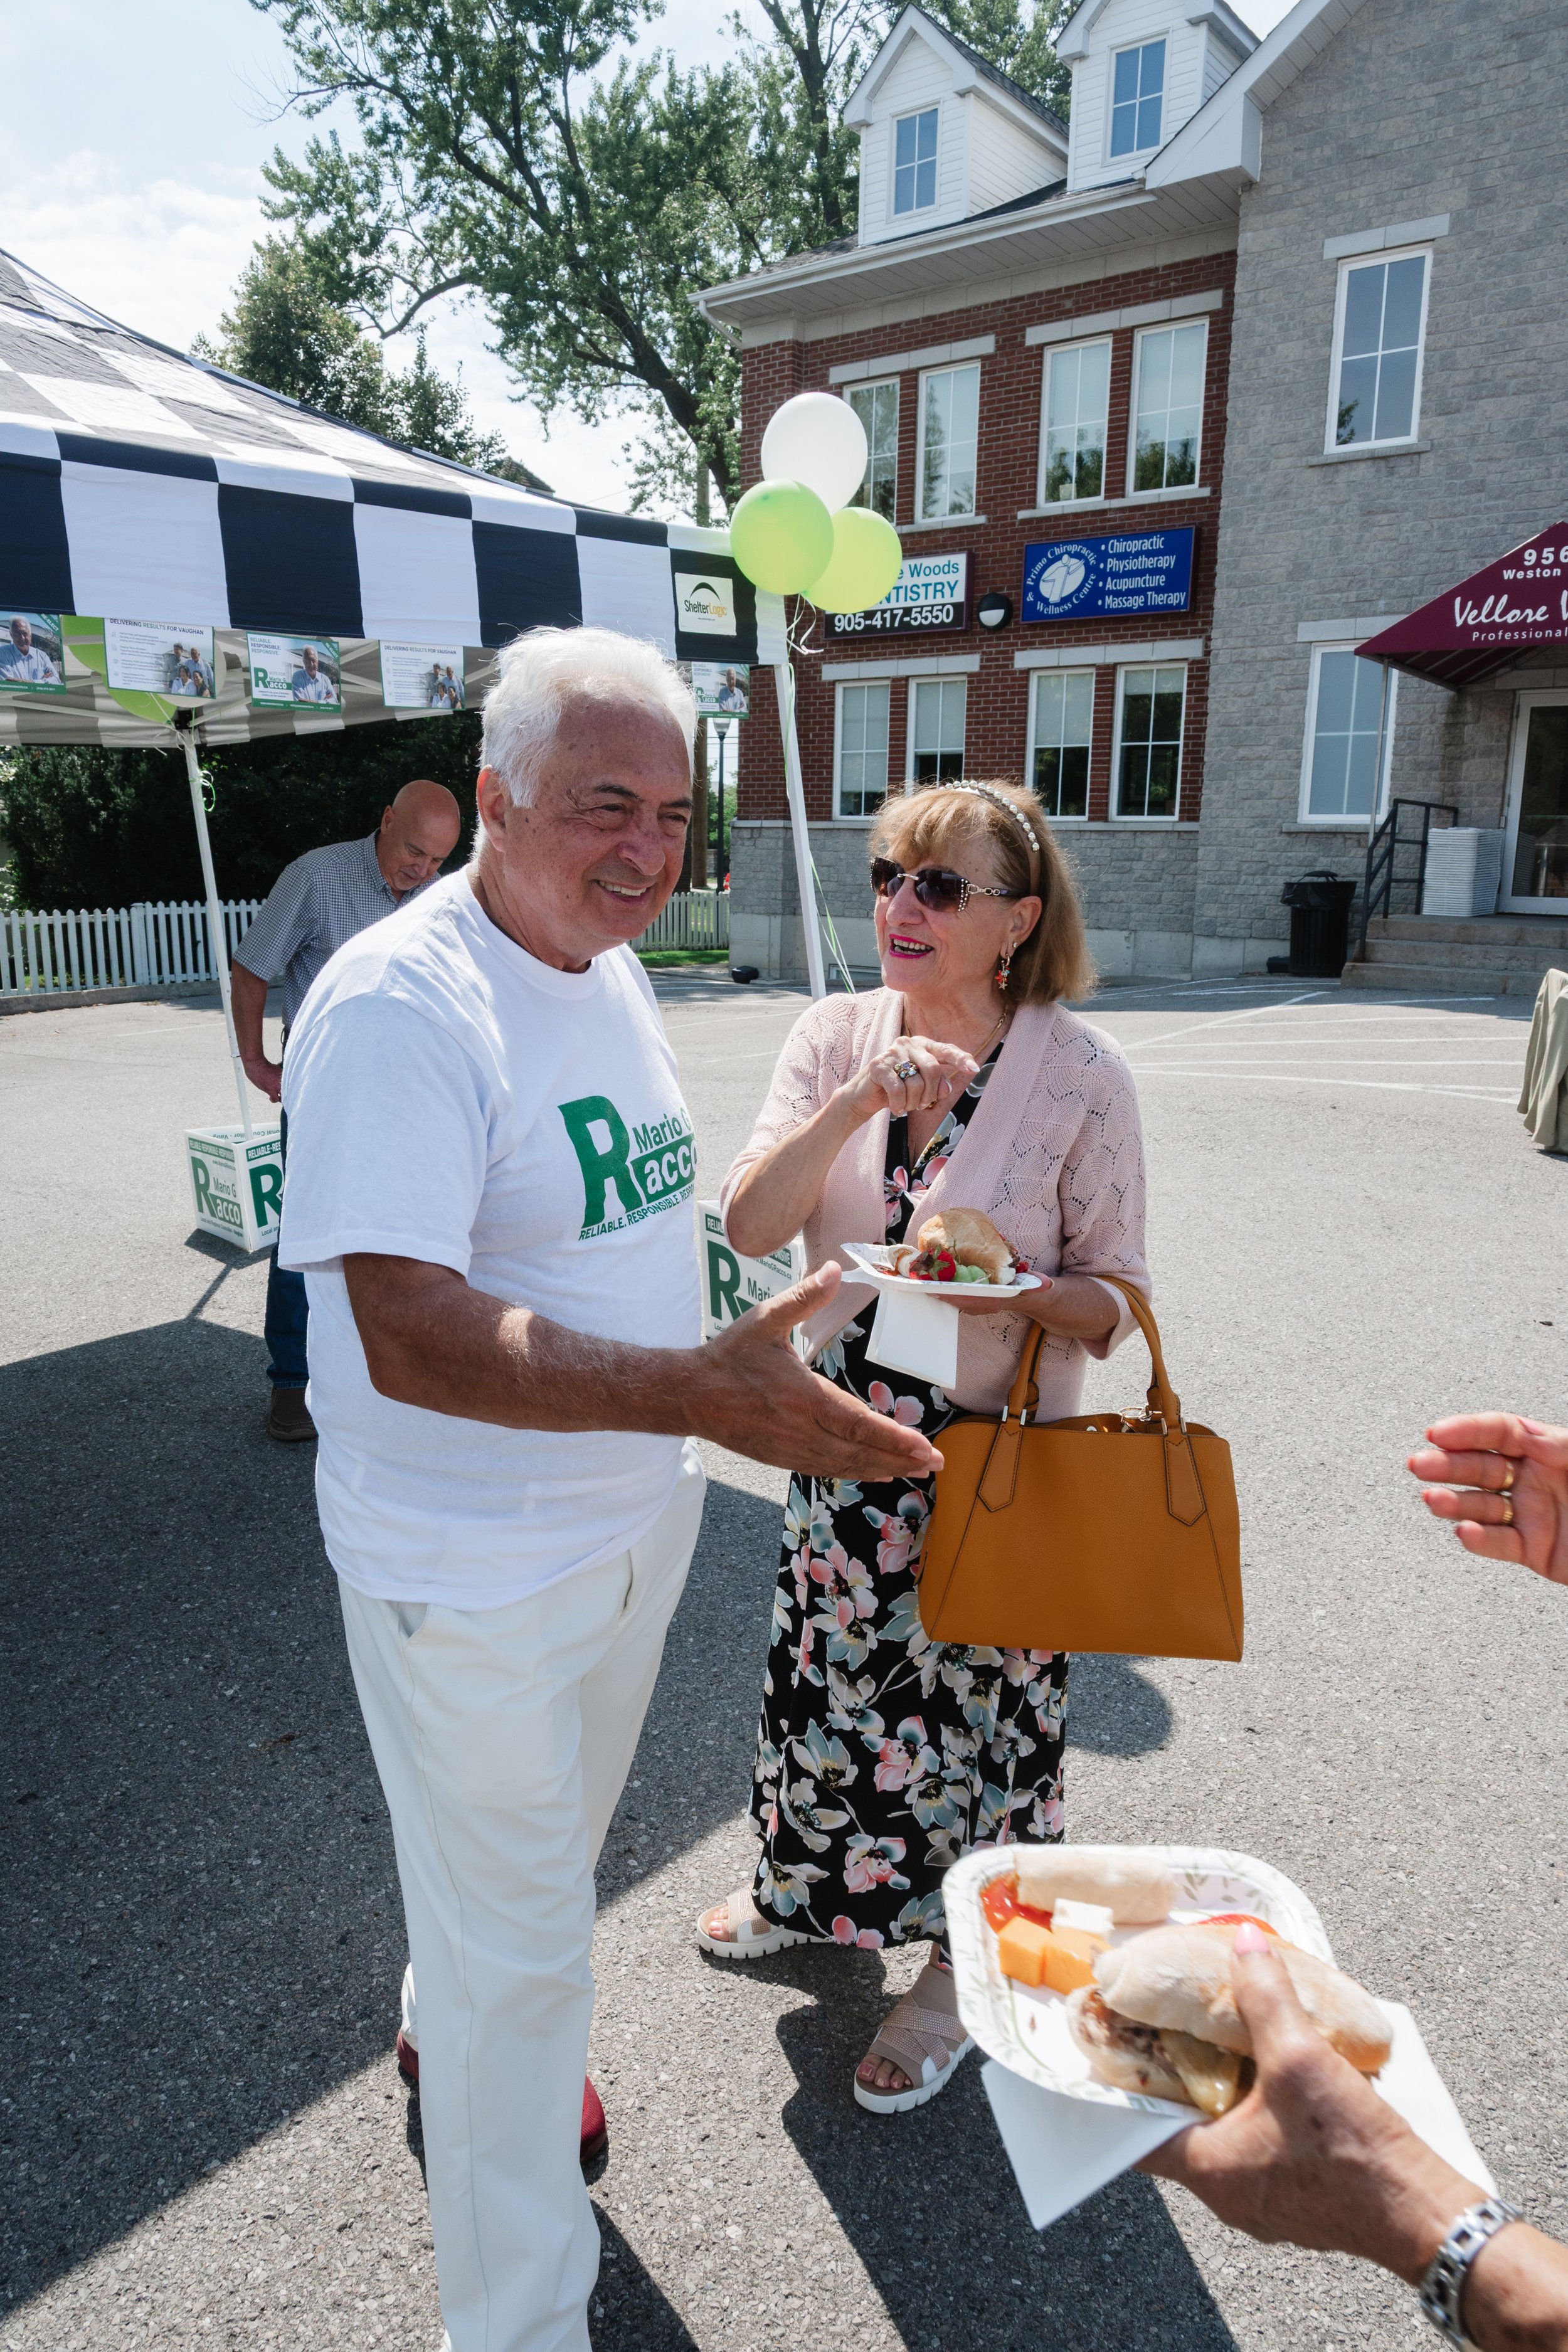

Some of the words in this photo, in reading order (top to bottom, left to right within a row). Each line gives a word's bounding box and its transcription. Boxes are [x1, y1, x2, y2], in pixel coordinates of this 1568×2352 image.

[1108, 534, 1165, 554] Chiropractic
[908, 559, 960, 578] Woods
[1026, 556, 1047, 585] Primo
[1047, 544, 1096, 566] Chiropractic
[1106, 554, 1176, 573] Physiotherapy
[1106, 573, 1166, 591] Acupuncture
[1503, 568, 1561, 580] Weston
[1026, 591, 1034, 602] &
[1036, 600, 1072, 615] Wellness
[1072, 573, 1096, 604] Centre
[1104, 594, 1145, 610] Massage
[1147, 591, 1186, 607] Therapy
[834, 604, 954, 632] 905-417-5550
[1454, 594, 1549, 627] Vellore
[110, 618, 142, 627] DELIVERING
[1472, 627, 1568, 641] Professional
[632, 1113, 683, 1154] Mario
[213, 1177, 230, 1195] Mario
[231, 1184, 236, 1198] G
[578, 1217, 627, 1241] RELIABLE.
[626, 1194, 681, 1226] RESPONSIBLE.
[261, 1227, 273, 1236] Local
